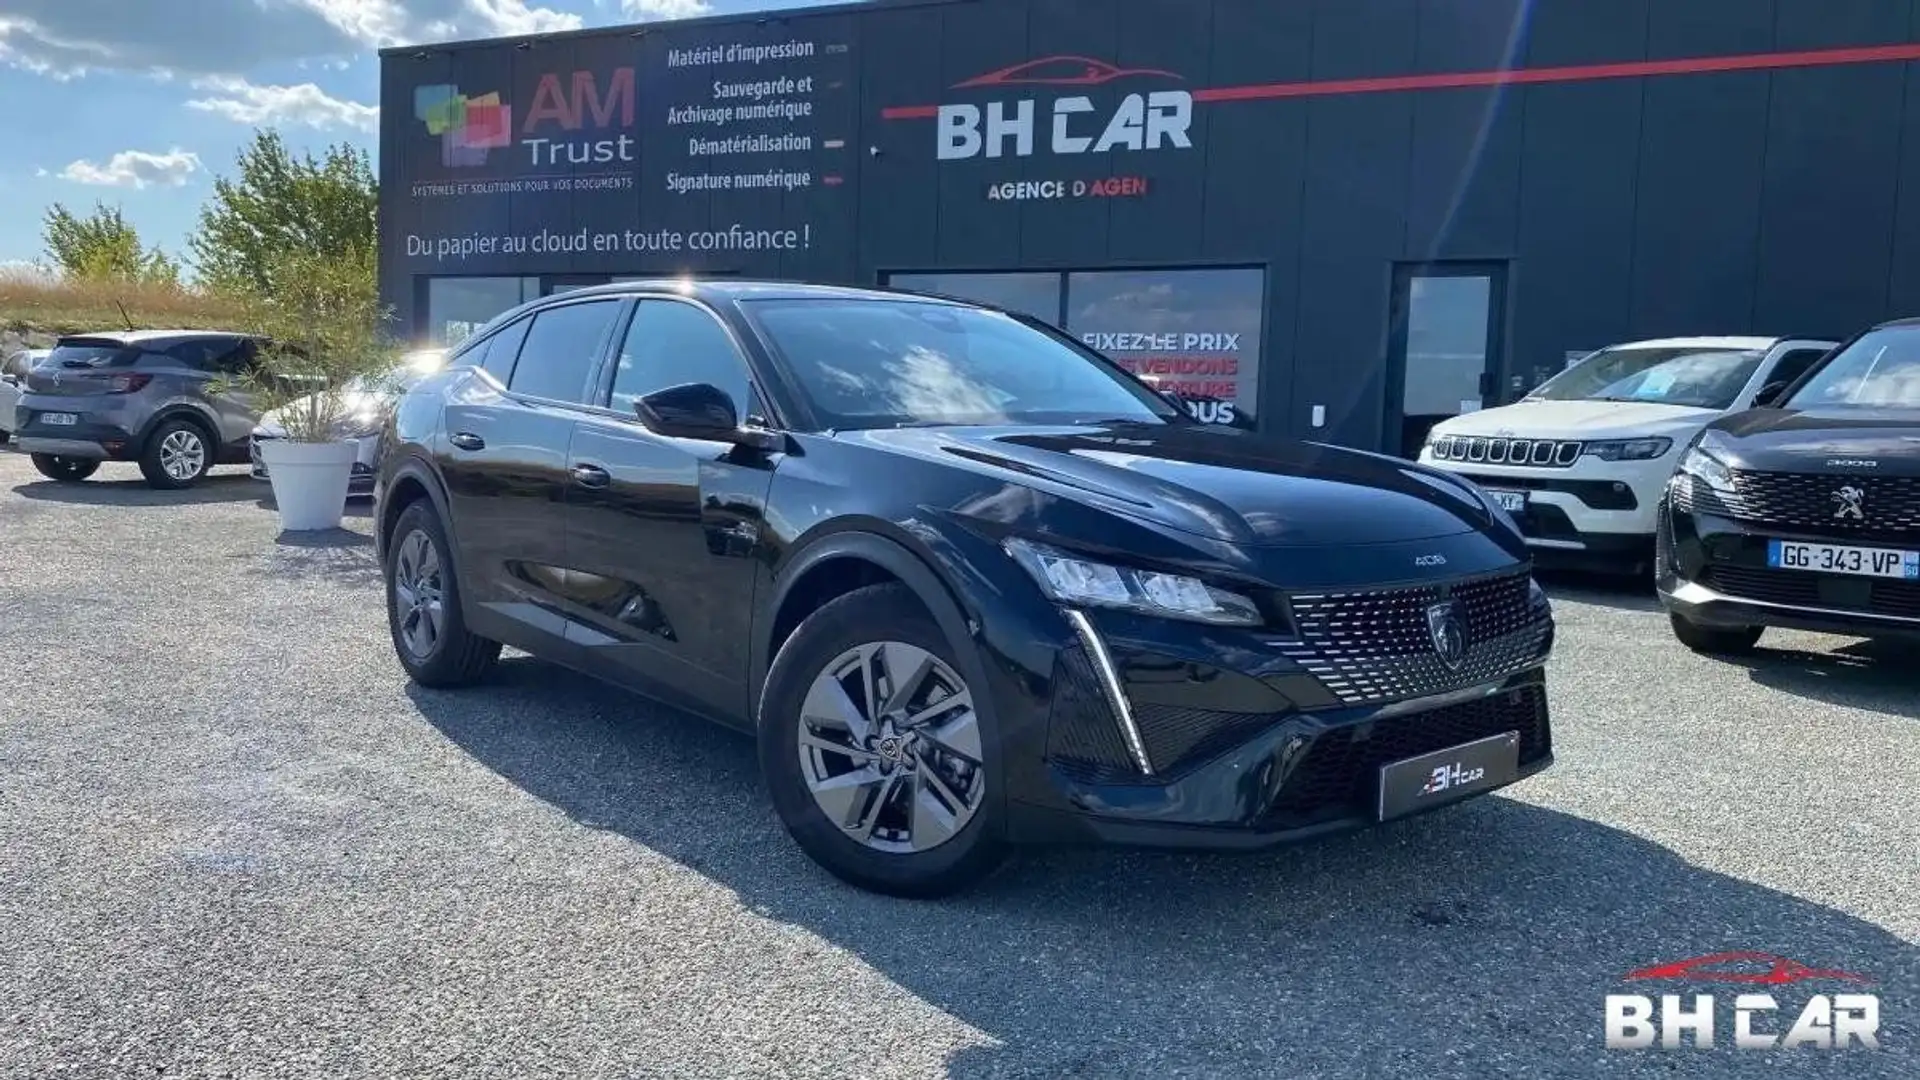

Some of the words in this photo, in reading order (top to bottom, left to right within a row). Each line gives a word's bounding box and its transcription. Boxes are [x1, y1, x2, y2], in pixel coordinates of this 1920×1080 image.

[668, 45, 723, 67] Matériel
[726, 40, 814, 64] d'impression
[523, 67, 635, 133] AM
[713, 76, 795, 100] Sauvegarde
[797, 76, 813, 93] et
[667, 105, 733, 126] Archivage
[735, 101, 813, 121] numérique
[937, 99, 1034, 160] BH
[1052, 90, 1192, 154] CAR
[521, 134, 635, 165] Trust
[689, 133, 812, 156] Dématérialisation
[471, 180, 522, 194] SOLUTIONS
[574, 176, 634, 190] DOCUMENTS
[667, 172, 731, 195] Signature
[734, 169, 811, 191] numérique
[988, 180, 1065, 200] AGENCE
[1091, 176, 1147, 196] AGEN
[407, 234, 432, 257] Du
[438, 231, 497, 262] papier
[502, 235, 526, 253] au
[531, 227, 588, 252] cloud
[593, 233, 619, 251] en
[624, 228, 682, 251] toute
[688, 223, 797, 250] confiance
[1151, 332, 1177, 350] LE
[1184, 332, 1239, 351] PRIX
[1142, 358, 1238, 374] VENDONS
[1783, 545, 1900, 574] GG-343-VP
